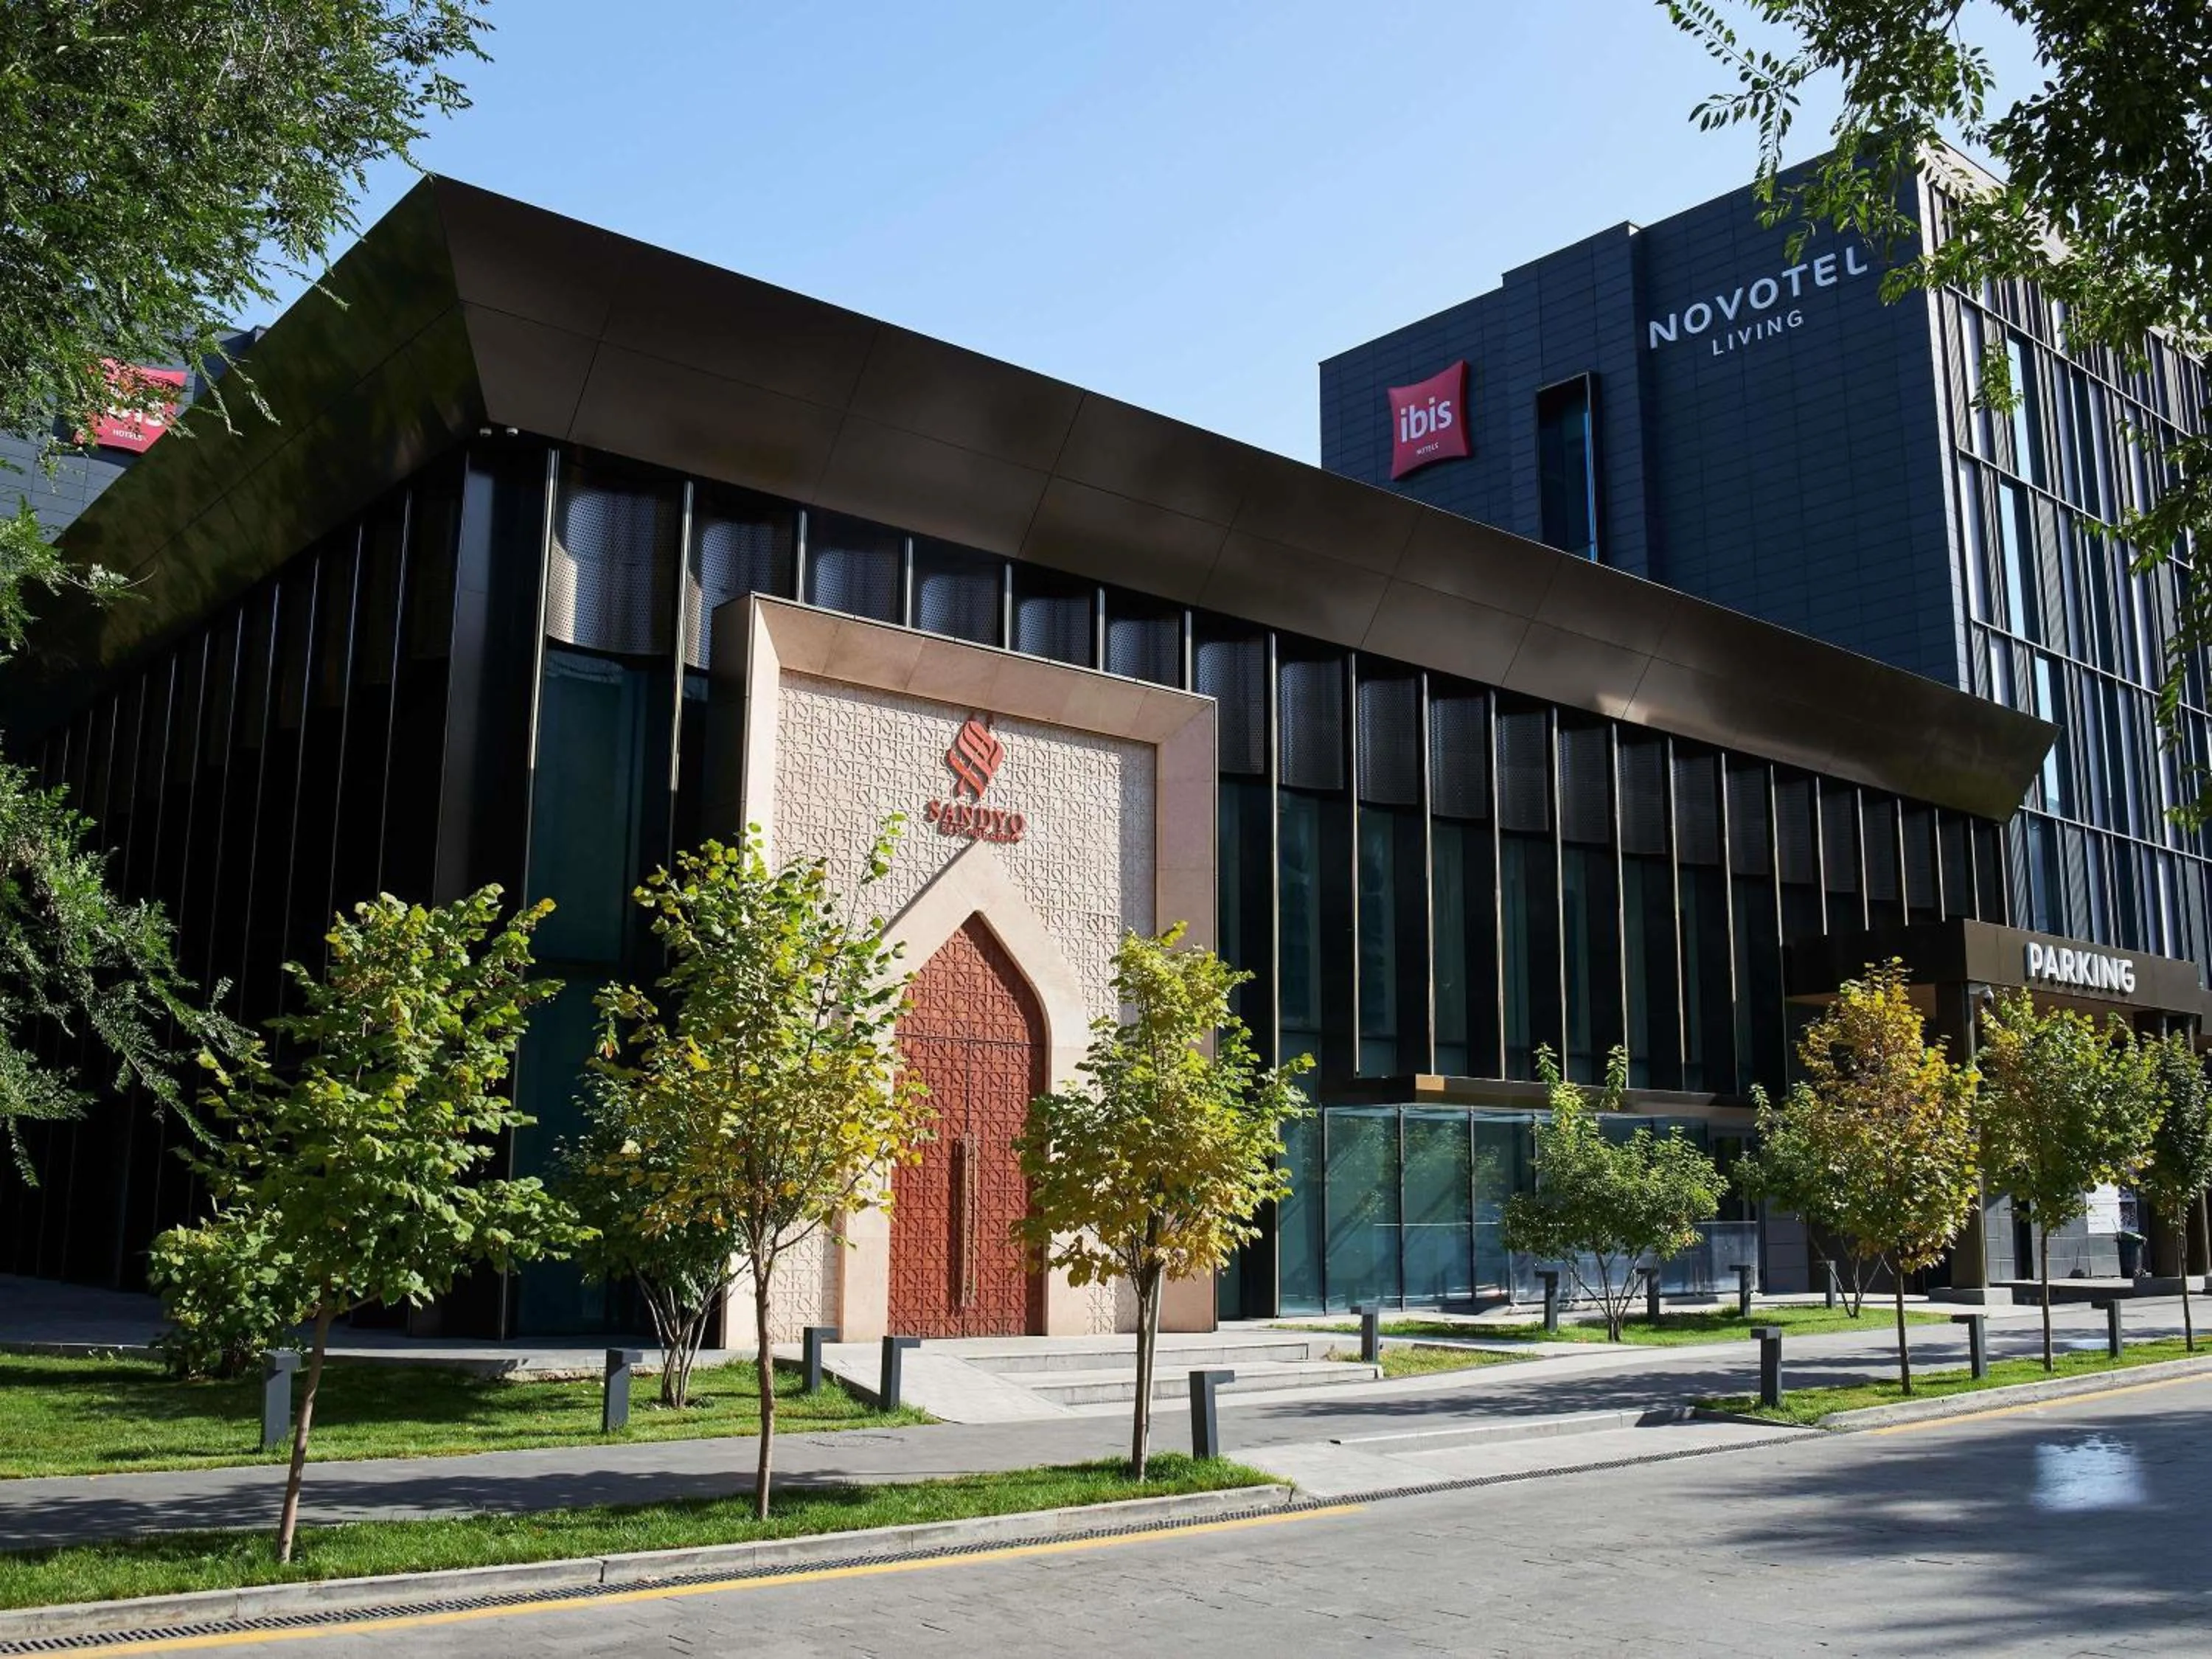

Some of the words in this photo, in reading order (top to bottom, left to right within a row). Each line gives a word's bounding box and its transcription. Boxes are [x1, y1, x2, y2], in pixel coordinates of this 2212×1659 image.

[1649, 246, 1868, 349] NOVOTEL
[1712, 310, 1804, 356] LIVING
[113, 428, 142, 441] HOTELS
[1400, 397, 1452, 443] ibis
[2026, 942, 2135, 993] PARKING
